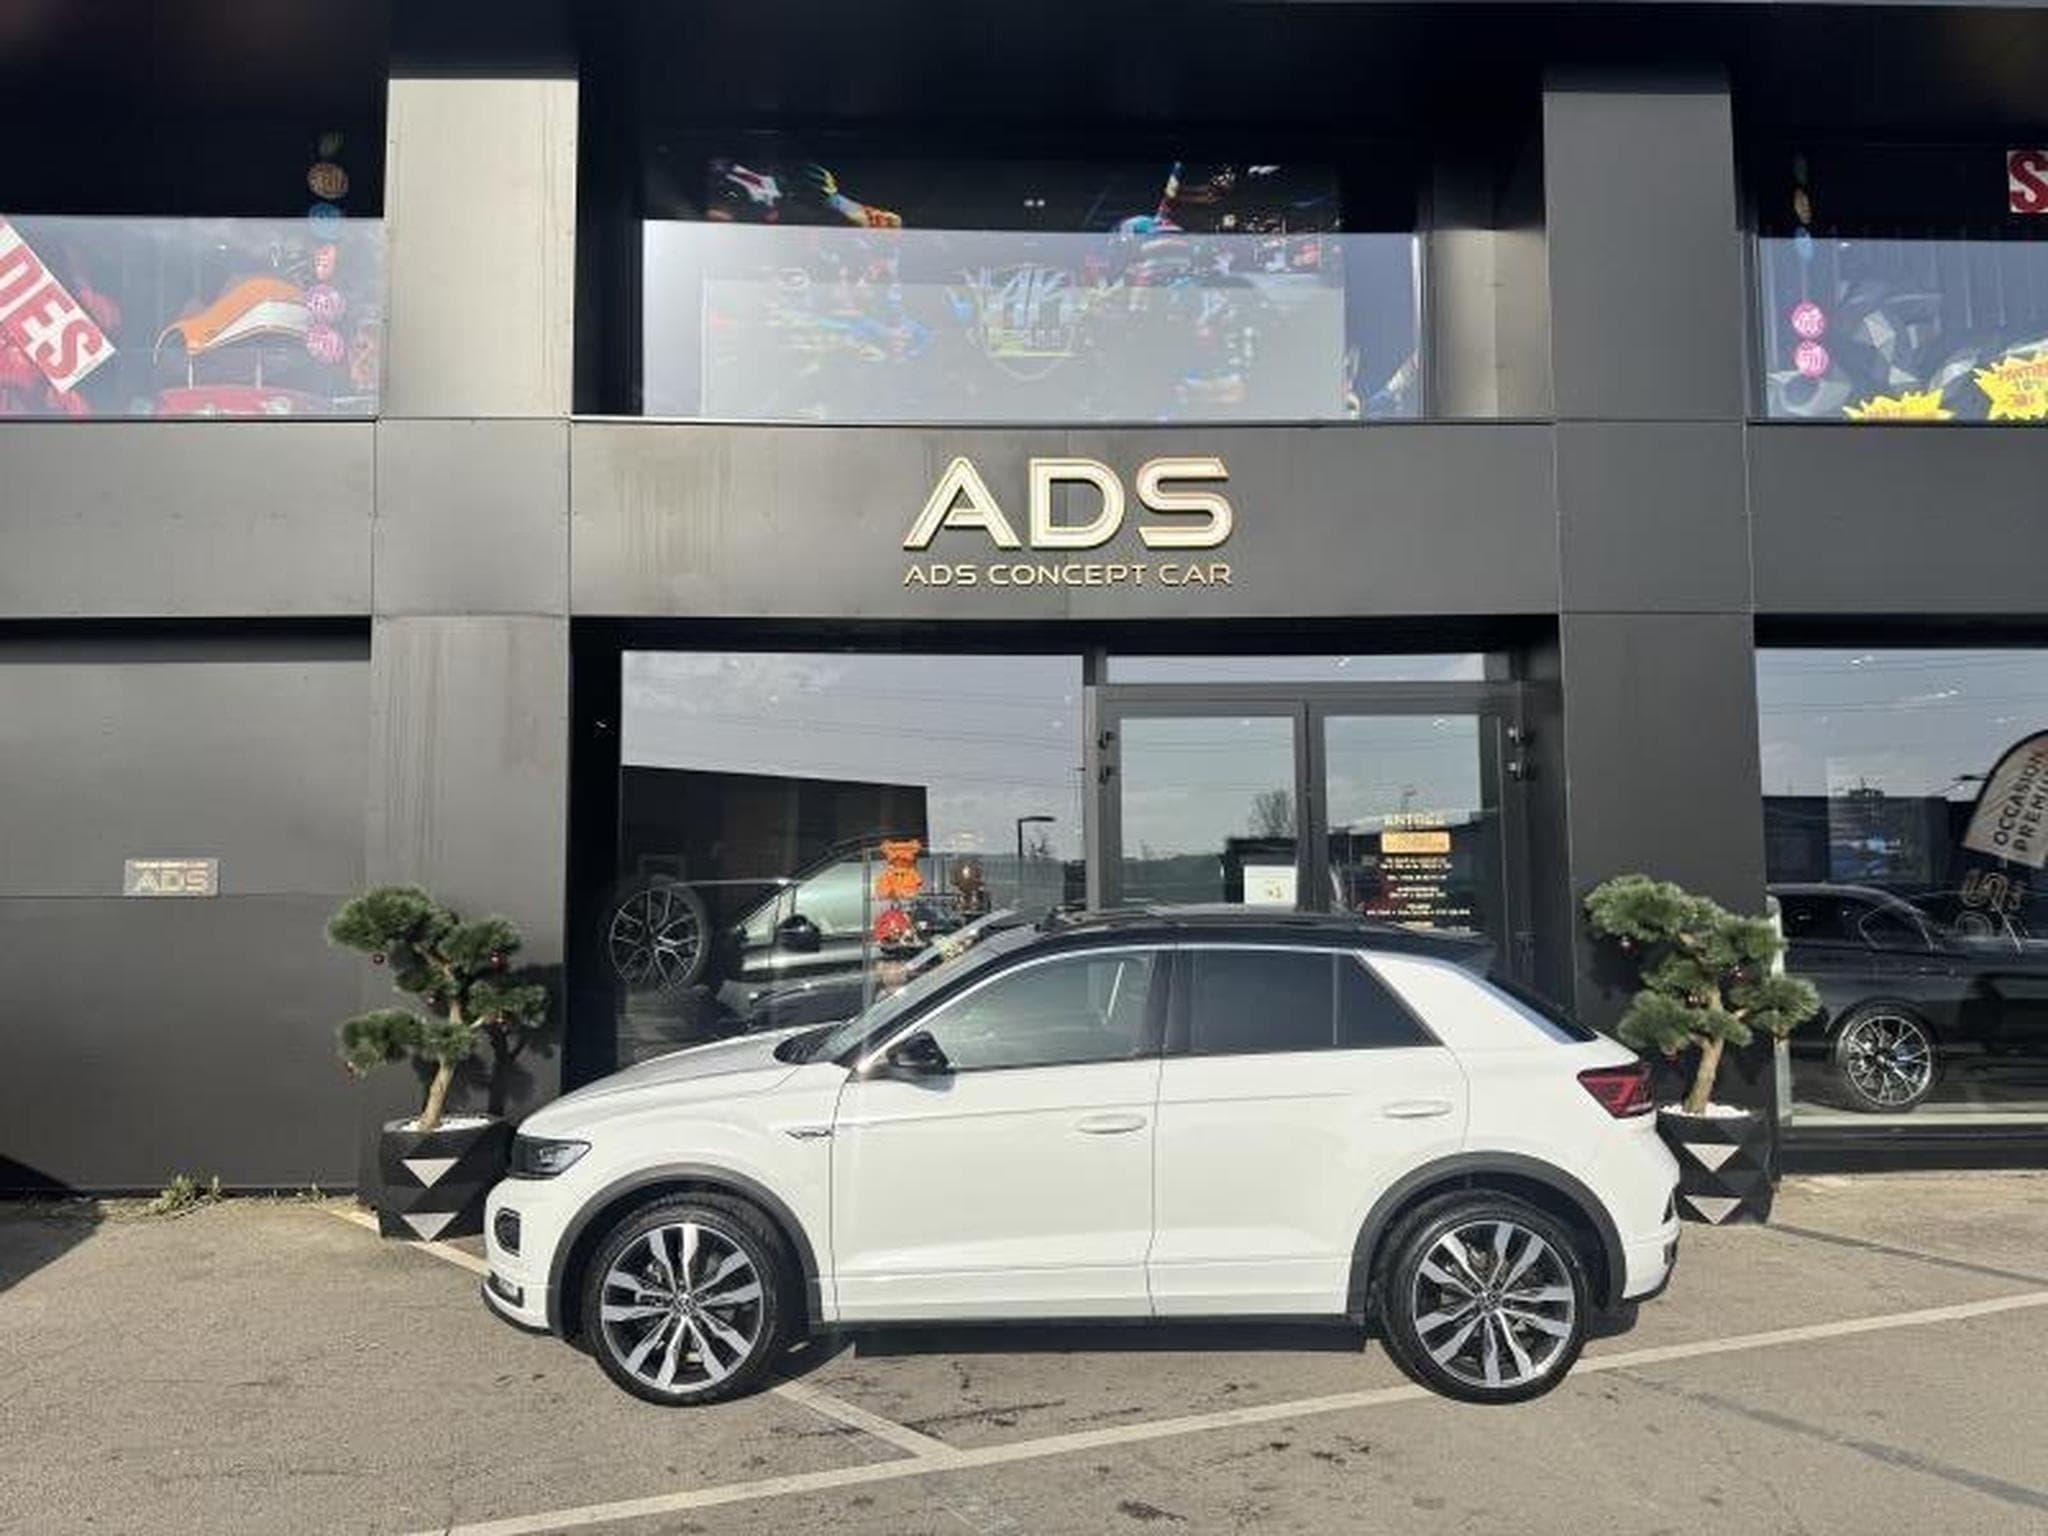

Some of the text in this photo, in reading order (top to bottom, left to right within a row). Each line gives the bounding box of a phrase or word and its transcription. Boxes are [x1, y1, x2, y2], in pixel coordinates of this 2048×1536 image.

[903, 456, 1233, 550] ADS
[904, 564, 1232, 586] ADS CONCEPT CAR
[1993, 751, 2045, 847] OCCASION
[132, 869, 209, 892] ADS
